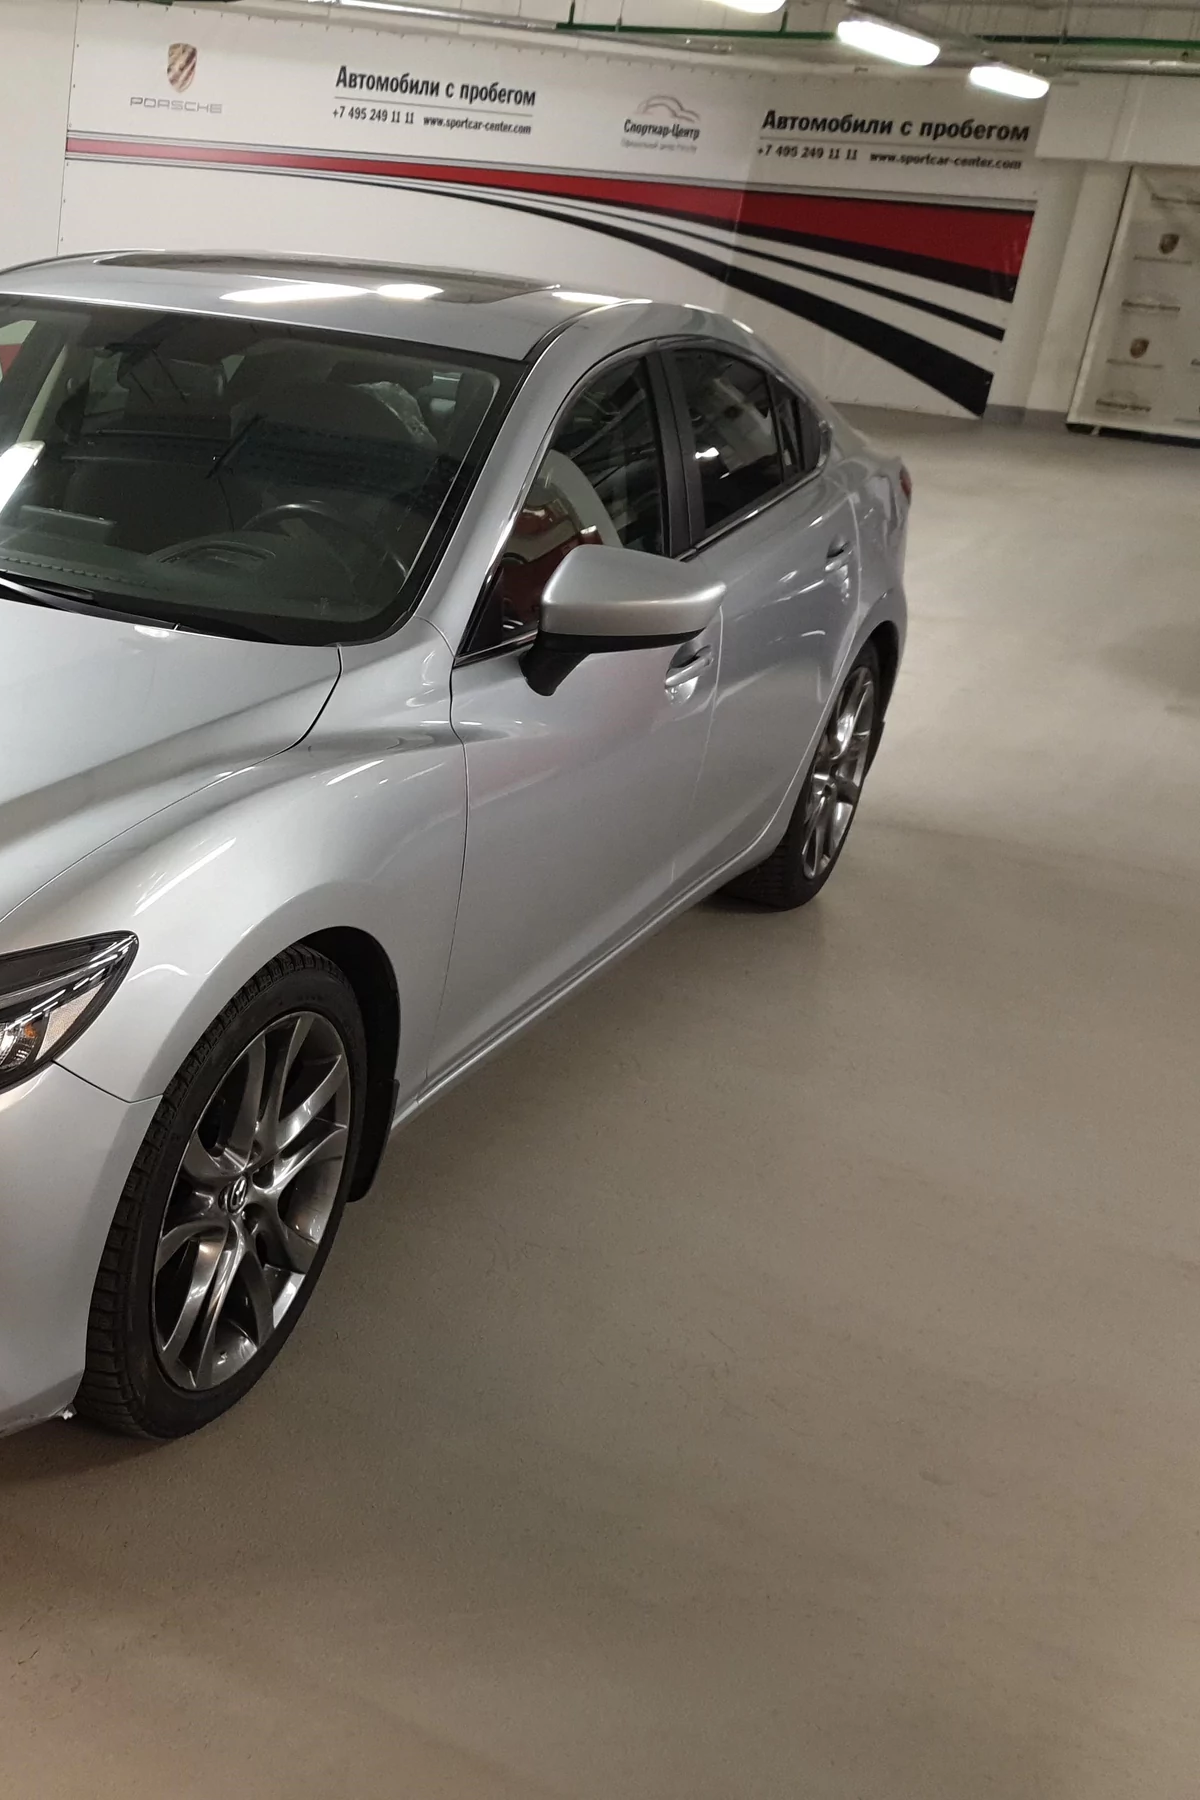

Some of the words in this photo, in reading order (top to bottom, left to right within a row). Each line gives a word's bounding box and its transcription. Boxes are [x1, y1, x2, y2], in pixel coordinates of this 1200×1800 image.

[335, 65, 440, 97] Автомобили
[445, 82, 455, 98] с
[459, 81, 536, 106] пробегом
[129, 96, 223, 114] PORSCHE
[332, 105, 346, 119] +7
[348, 107, 367, 120] 495
[369, 108, 388, 122] 249
[391, 110, 401, 124] 11
[405, 112, 415, 125] 11
[422, 115, 532, 135] www.sportcar-center.com
[762, 109, 894, 135] Автомобили
[900, 120, 913, 136] с
[919, 118, 1031, 142] пробегом
[800, 146, 825, 159] 249
[828, 147, 841, 160] 11
[845, 148, 858, 161] 11
[869, 152, 1022, 170] www.sportcar-center.com
